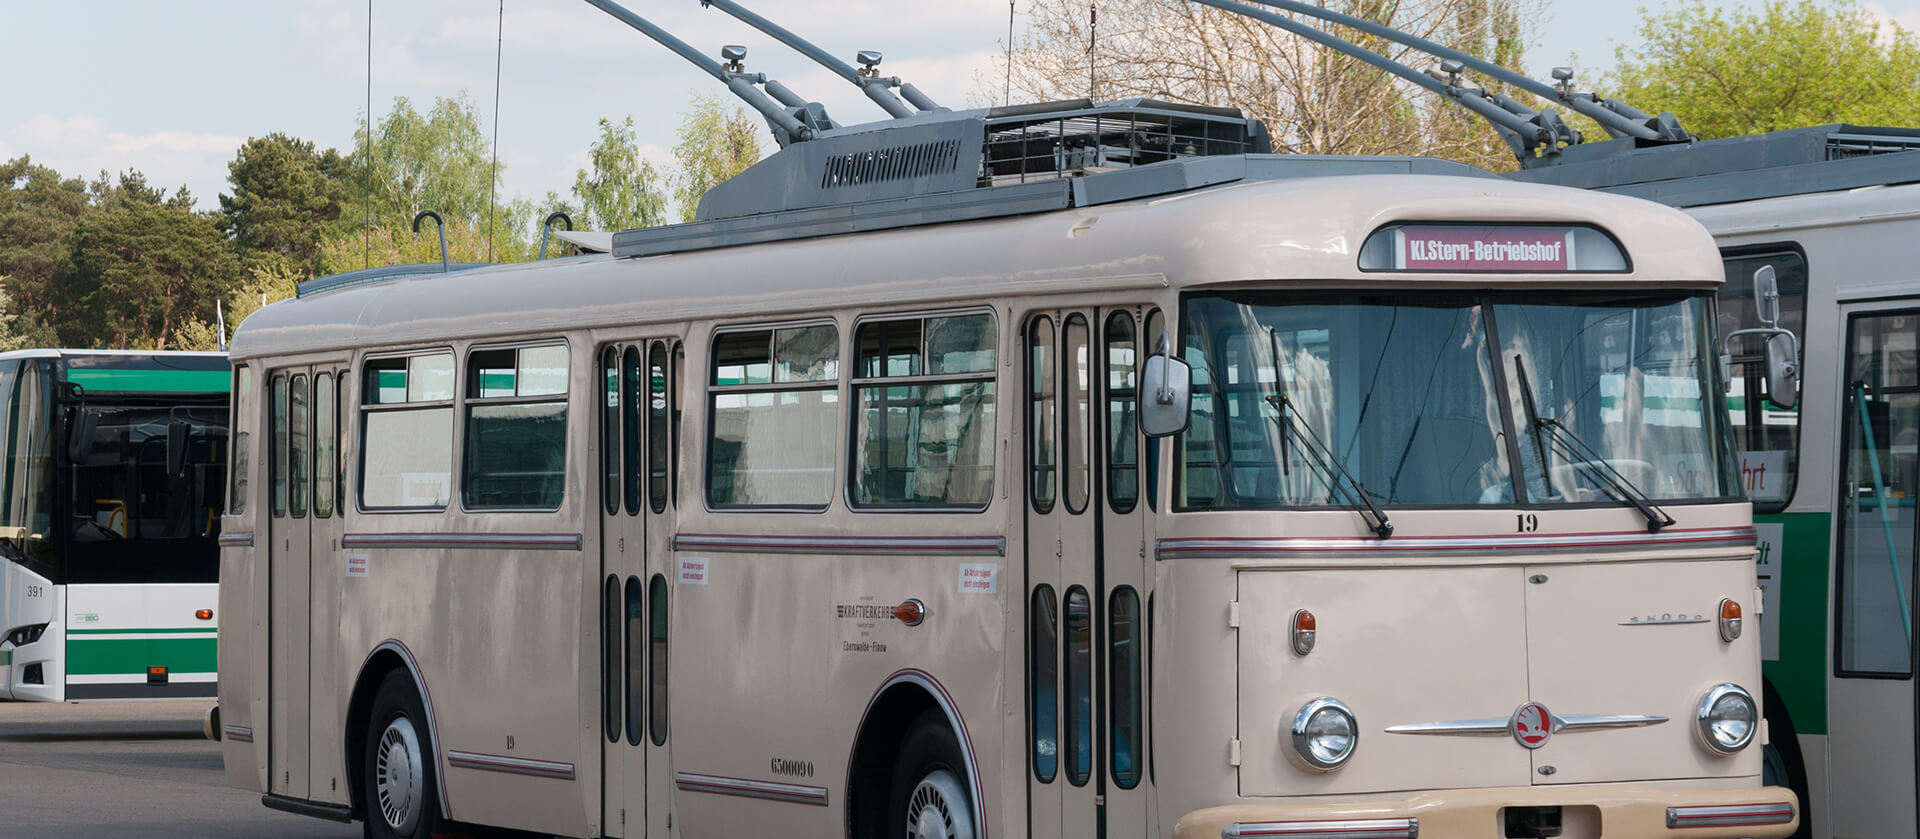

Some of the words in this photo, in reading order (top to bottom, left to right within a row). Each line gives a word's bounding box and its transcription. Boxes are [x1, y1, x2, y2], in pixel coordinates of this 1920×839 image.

[1516, 513, 1538, 532] 19
[27, 585, 43, 597] 391
[844, 605, 890, 619] KRAFTVERKEHR
[506, 735, 515, 750] 19
